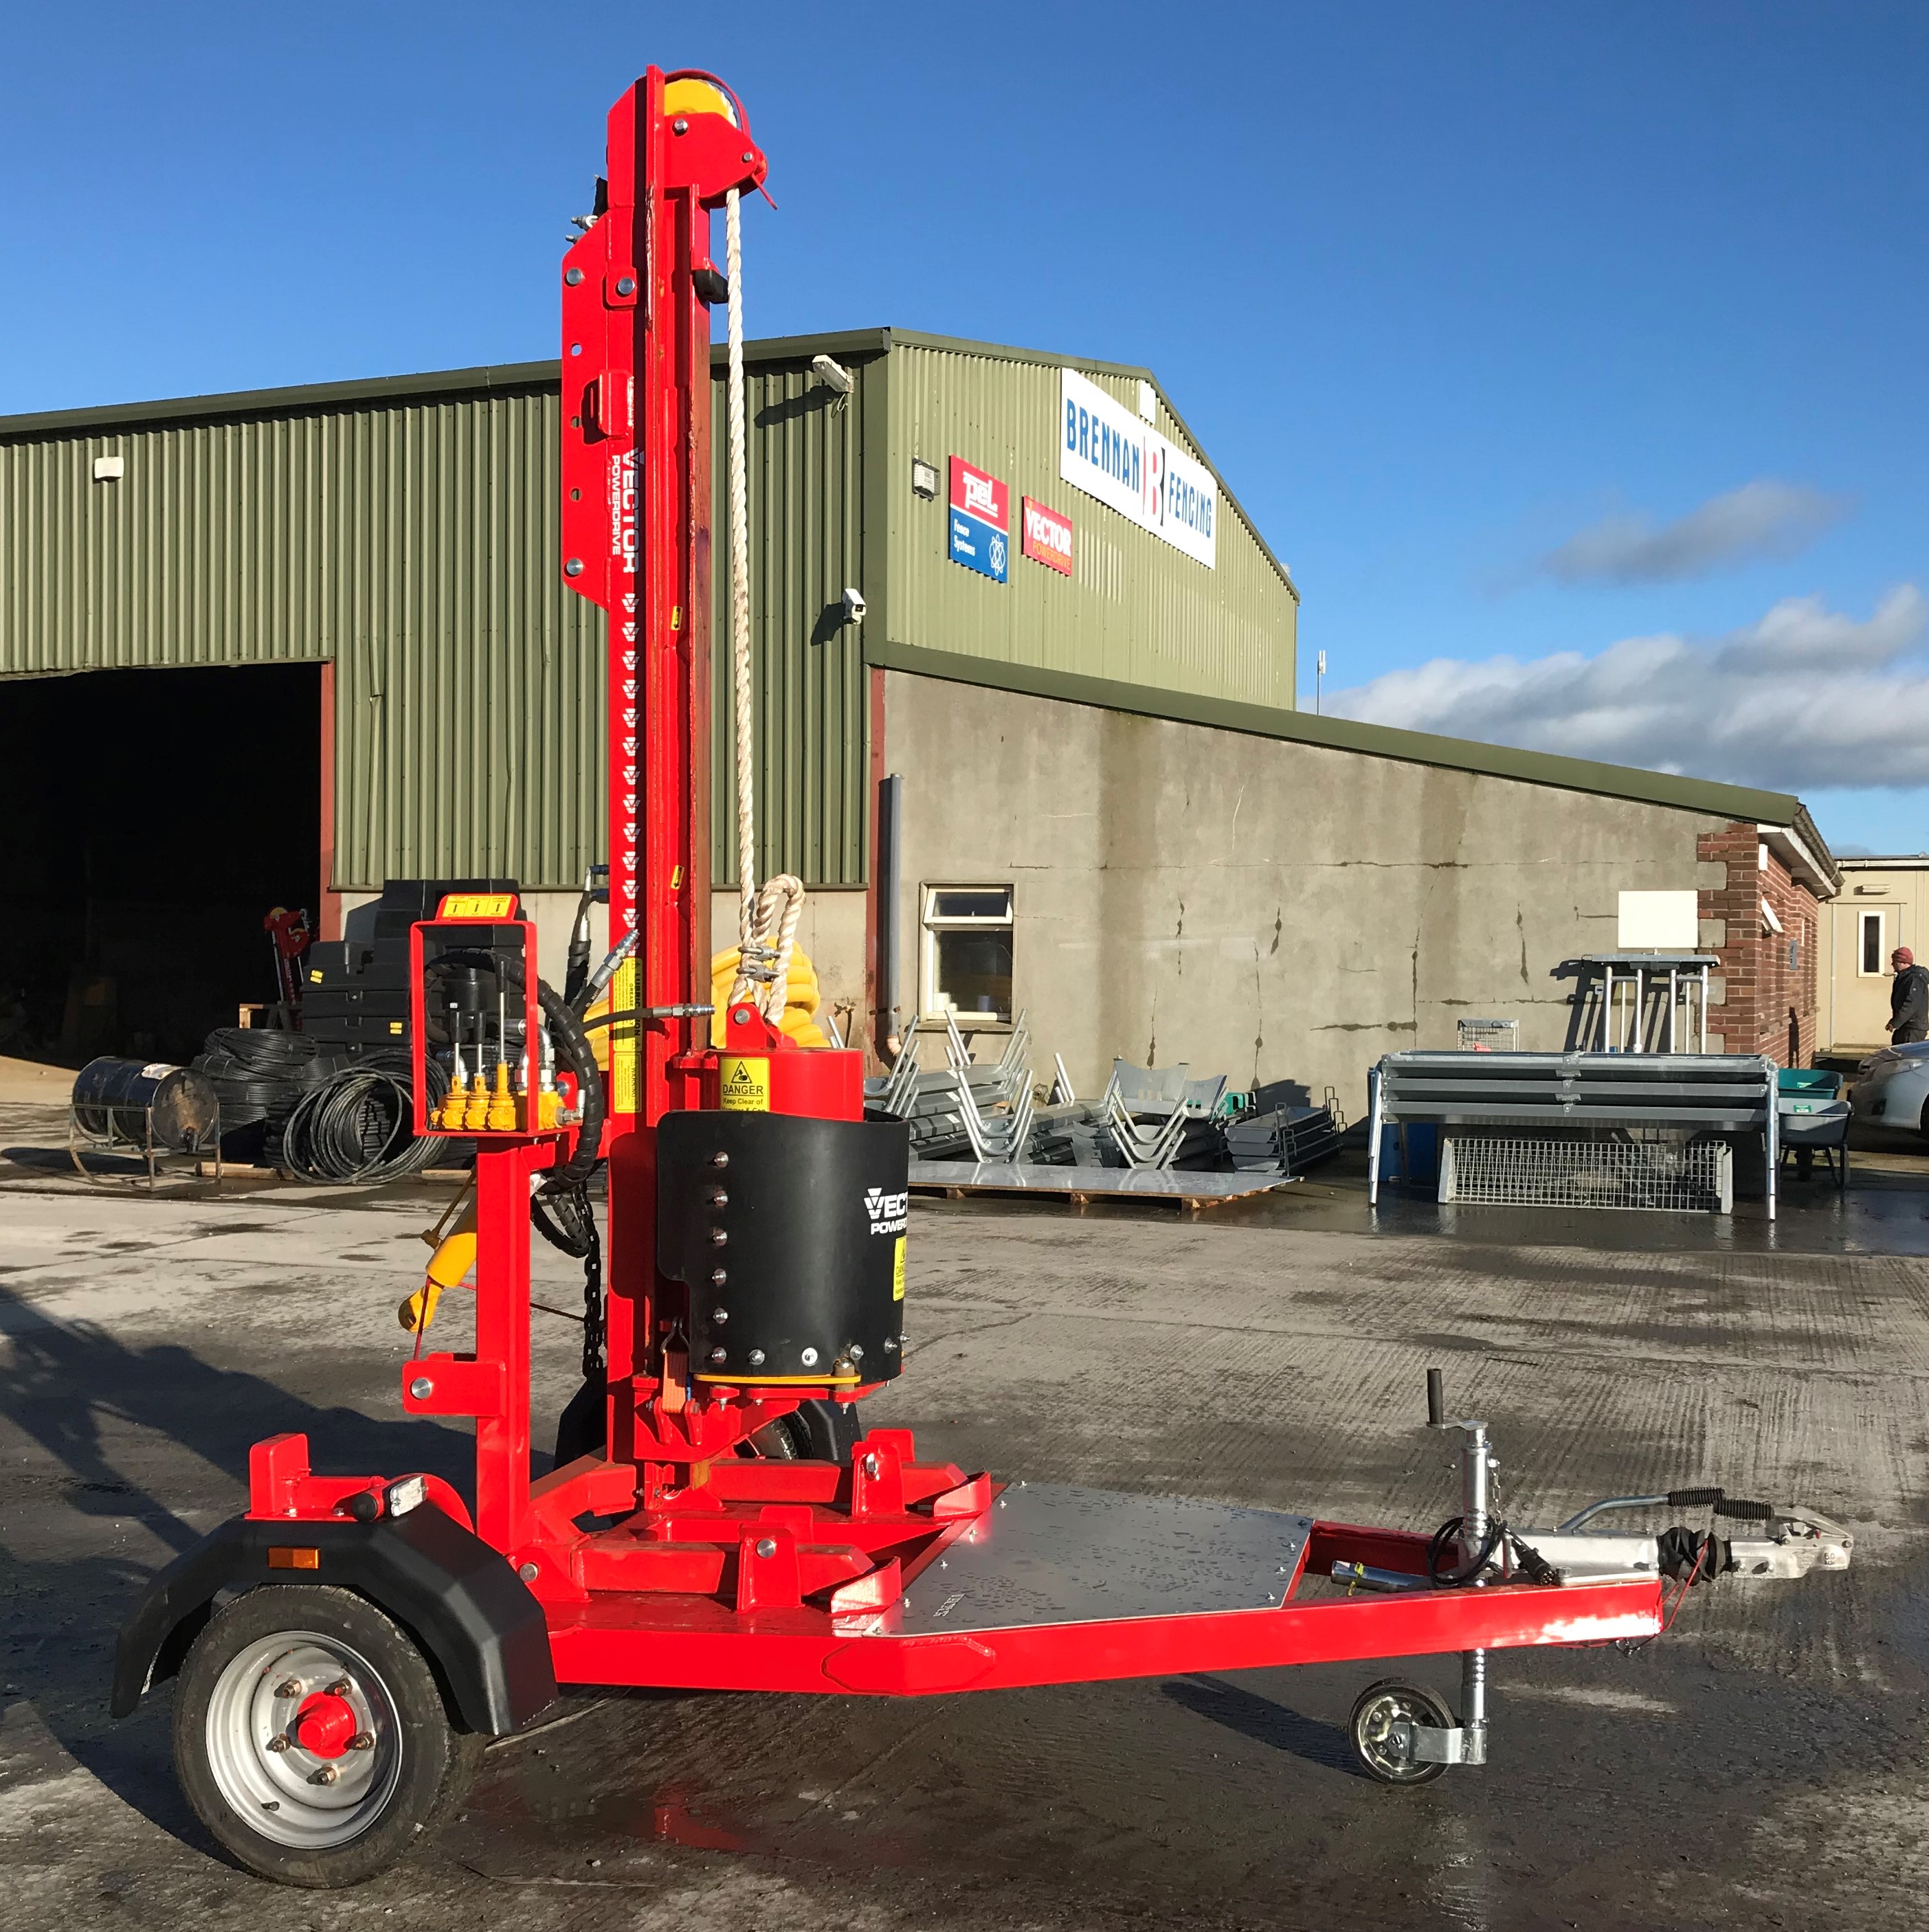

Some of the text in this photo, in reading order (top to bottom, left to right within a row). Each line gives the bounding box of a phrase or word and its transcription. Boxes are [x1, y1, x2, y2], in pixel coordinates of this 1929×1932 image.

[1067, 398, 1139, 494] BRENNAN
[1169, 471, 1212, 539] FENCING
[612, 455, 621, 556] POWERDRIVE
[623, 447, 645, 574] VECTOR
[954, 519, 970, 537] Fence
[1025, 504, 1071, 557] VECTOR
[954, 535, 976, 557] Systems
[1032, 540, 1071, 571] POWERDRIVE
[723, 1084, 763, 1094] DANGER
[723, 1097, 736, 1105] Keep
